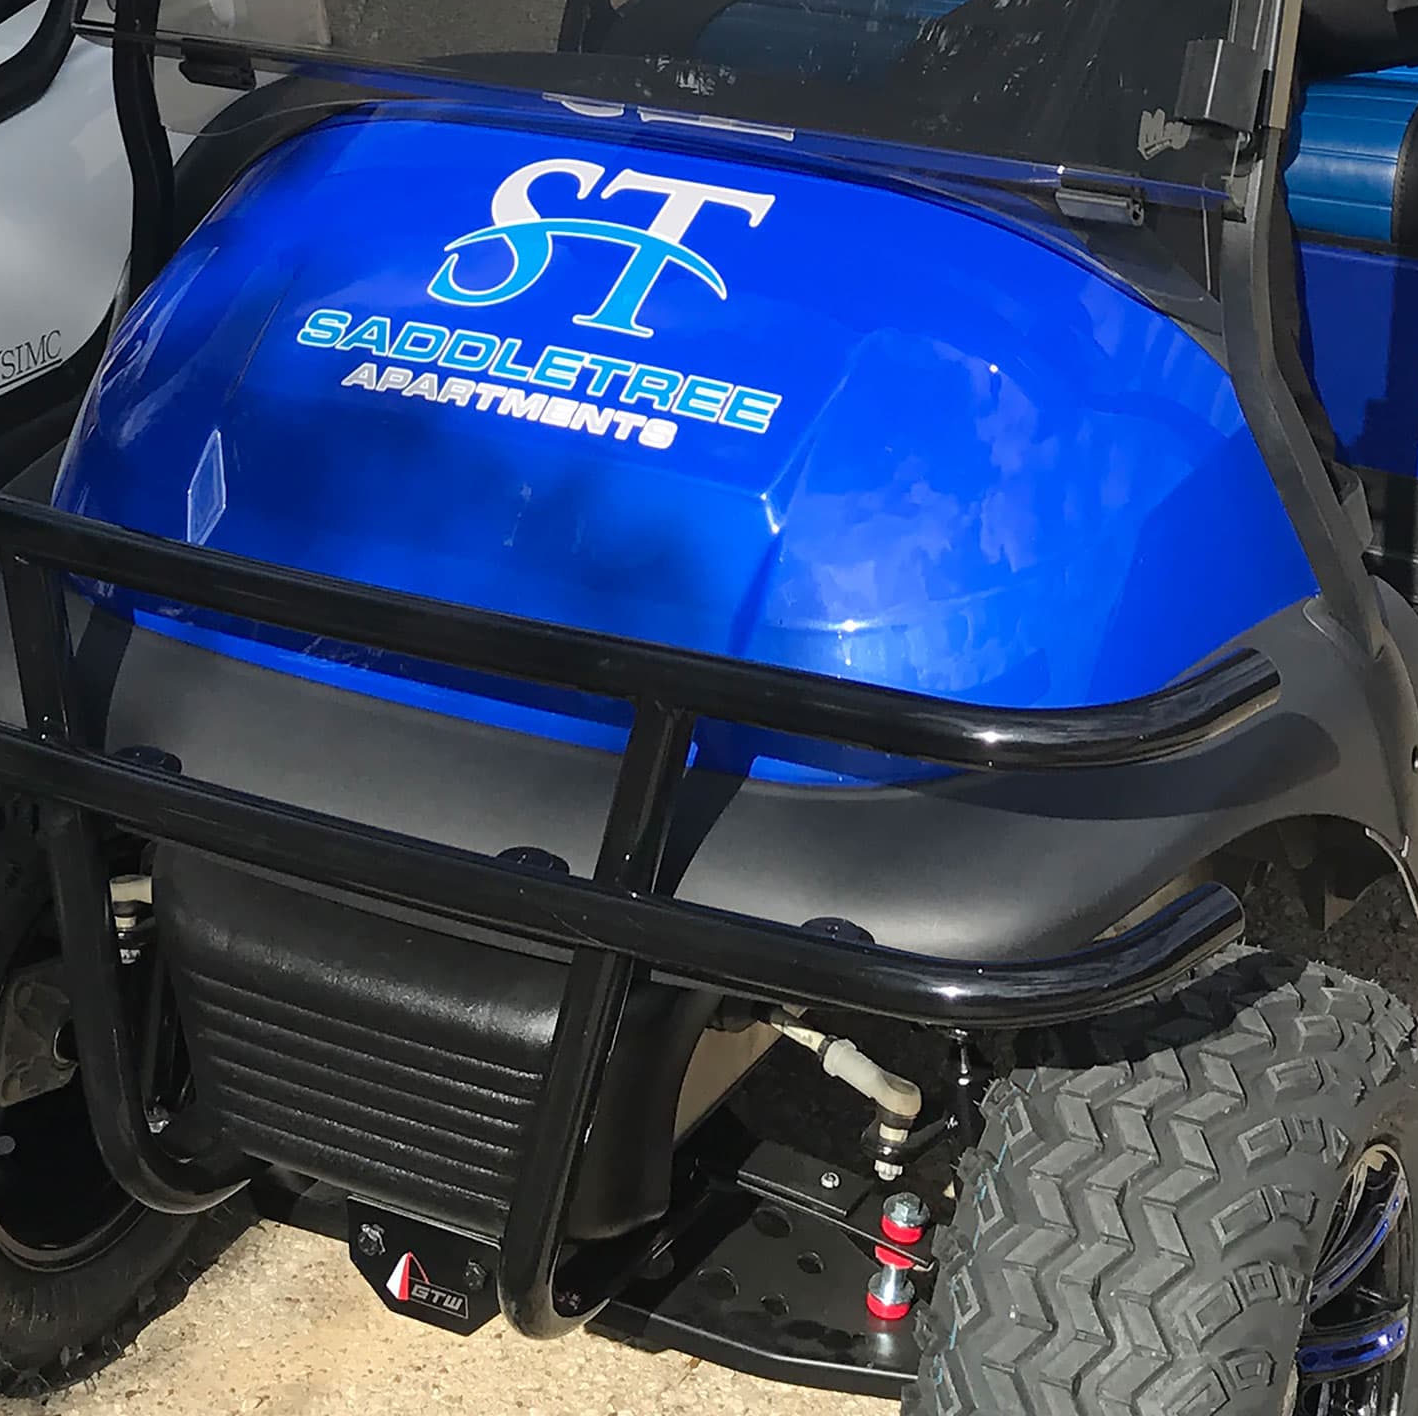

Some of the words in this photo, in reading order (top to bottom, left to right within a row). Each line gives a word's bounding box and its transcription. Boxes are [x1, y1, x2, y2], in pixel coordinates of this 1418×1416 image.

[426, 157, 776, 338] ST
[0, 329, 63, 380] SIMC
[297, 308, 783, 434] SADDLETREE
[340, 362, 679, 450] APARTMENTS
[411, 1283, 464, 1311] GTW
